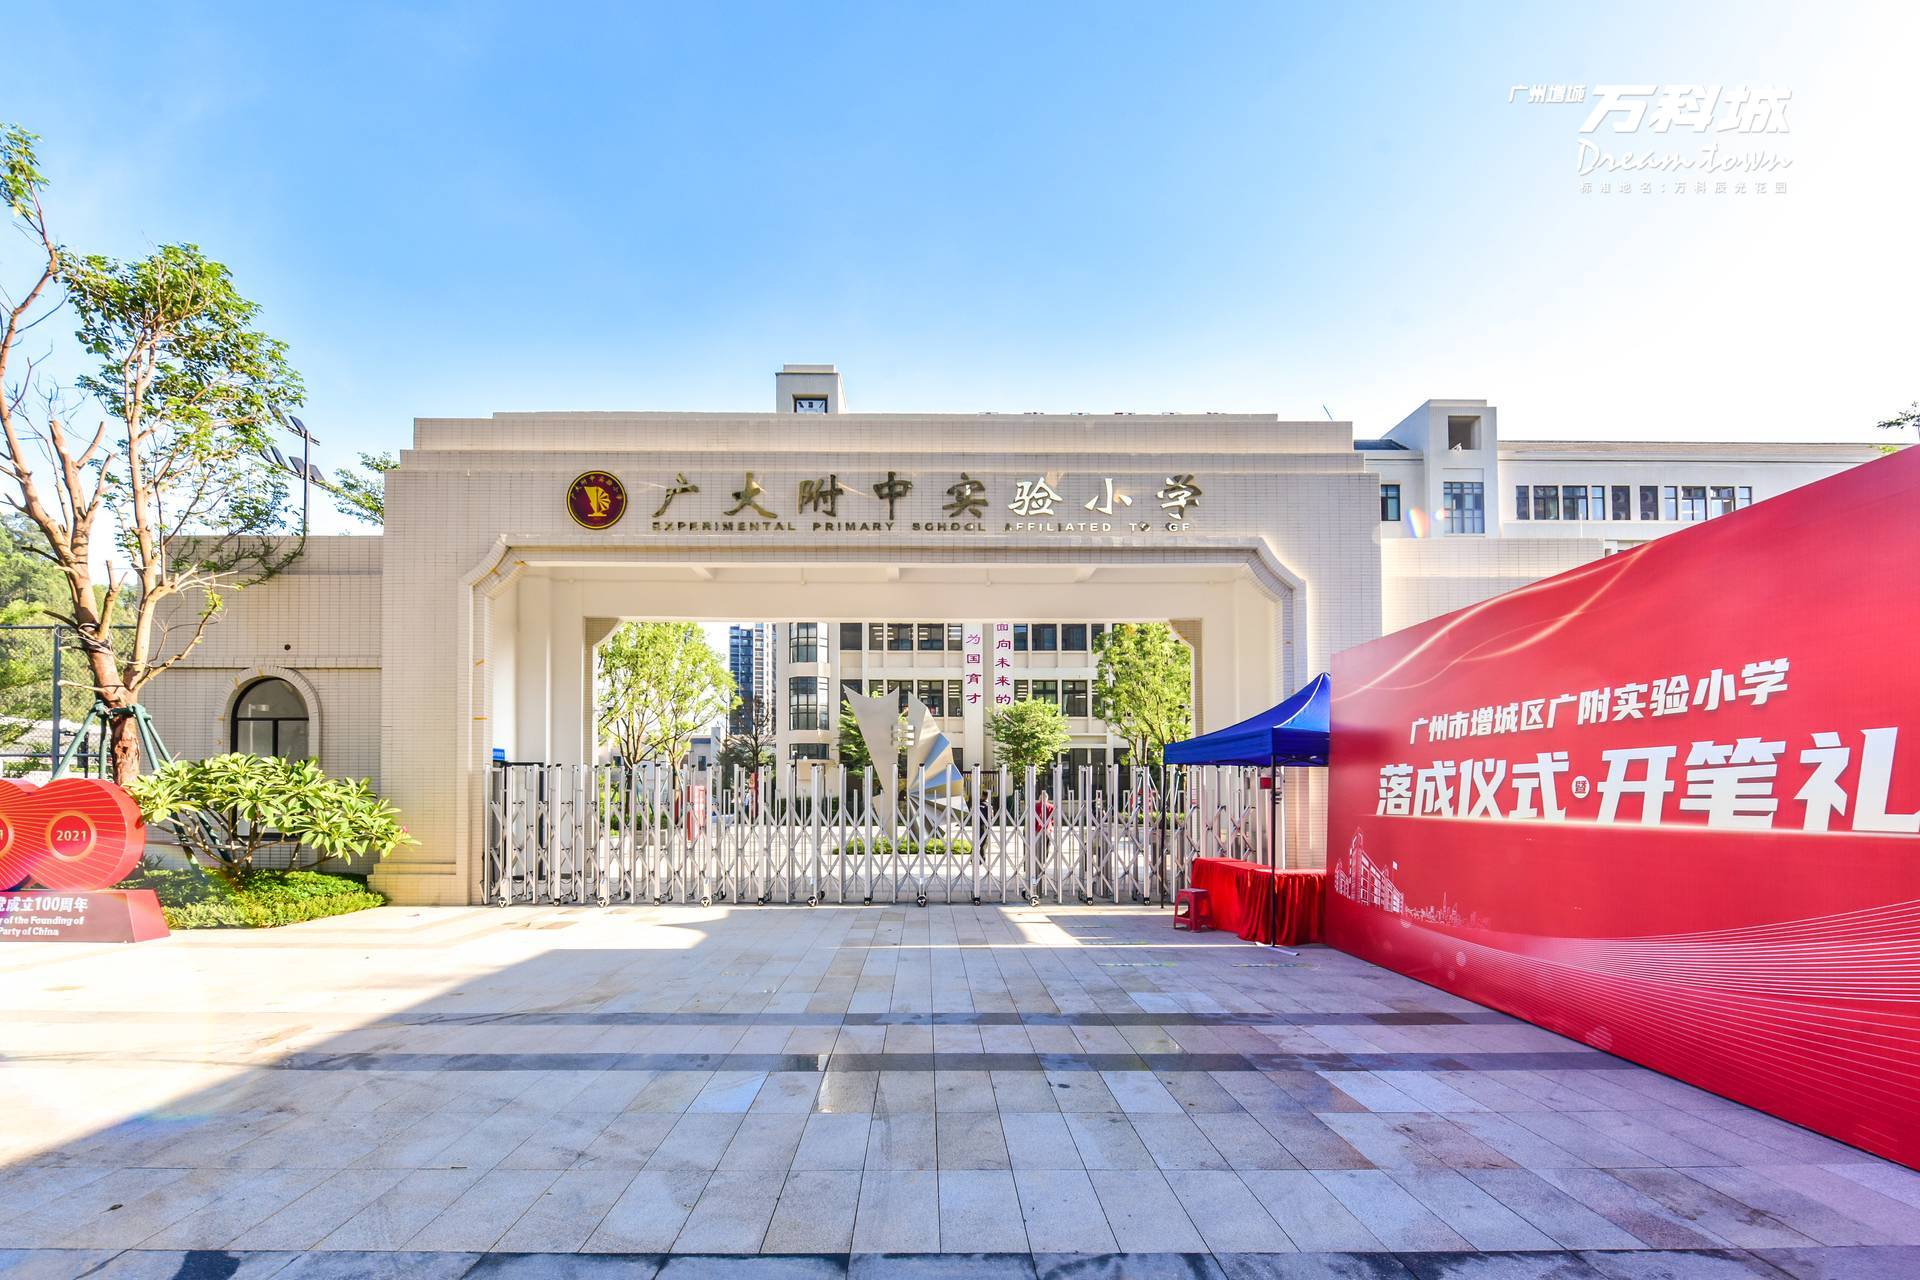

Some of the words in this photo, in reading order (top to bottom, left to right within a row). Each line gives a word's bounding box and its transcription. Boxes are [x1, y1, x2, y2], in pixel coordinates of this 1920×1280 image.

[652, 521, 796, 532] EXPERIMENTAL
[812, 522, 894, 532] PRIMARY
[912, 522, 986, 532] SCHOOL
[1004, 522, 1111, 532] AFFILIATED
[1129, 521, 1151, 532] TO
[1165, 522, 1190, 532] GF
[966, 634, 982, 704] 为国育才
[1409, 657, 1790, 745] 广州市增城区广附实验小学
[1376, 751, 1570, 822] 落成仪式
[1596, 726, 1920, 833] 开笔礼
[55, 830, 87, 842] 2021
[4, 915, 14, 924] of
[15, 915, 29, 924] the
[31, 915, 73, 926] Founding
[74, 915, 85, 925] of
[22, 926, 32, 935] of
[32, 926, 60, 936] China
